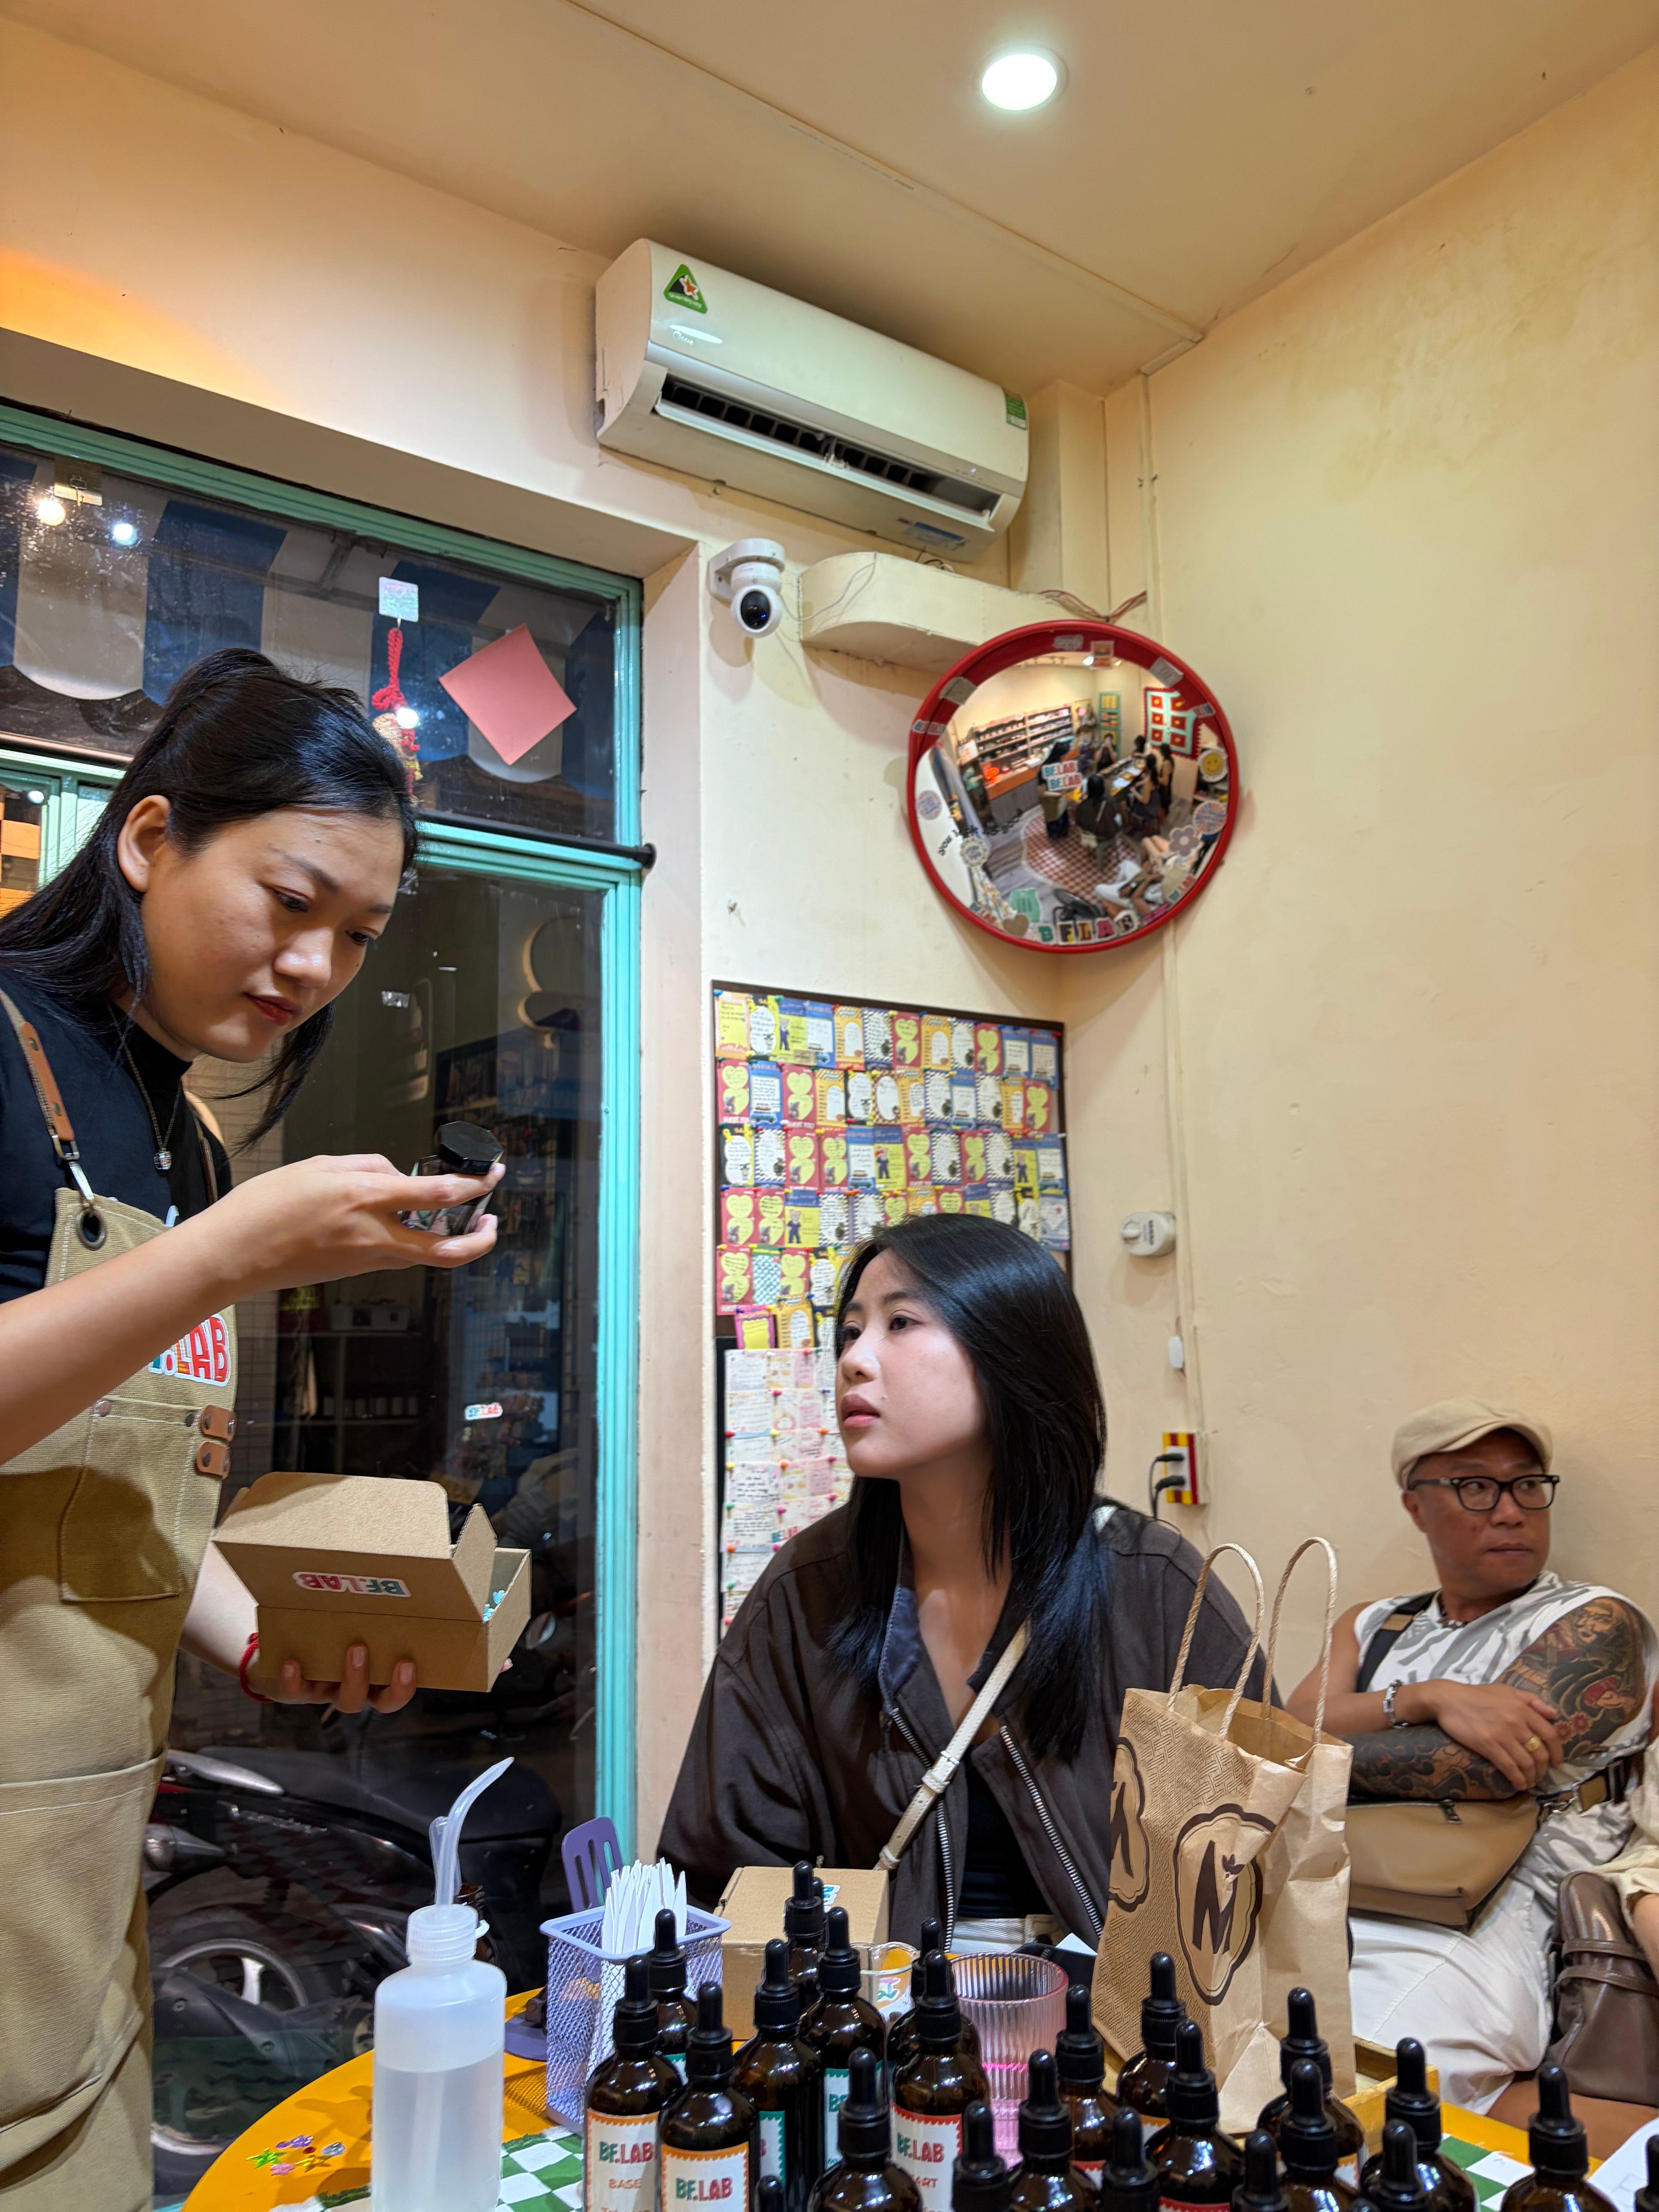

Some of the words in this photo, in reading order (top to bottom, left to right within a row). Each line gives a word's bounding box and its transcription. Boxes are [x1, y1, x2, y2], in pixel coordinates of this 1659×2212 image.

[298, 1574, 405, 1595] BF.LAB
[599, 2141, 654, 2164] BF.LAB
[608, 2178, 642, 2189] BASE
[676, 2177, 733, 2201] BF.LAB
